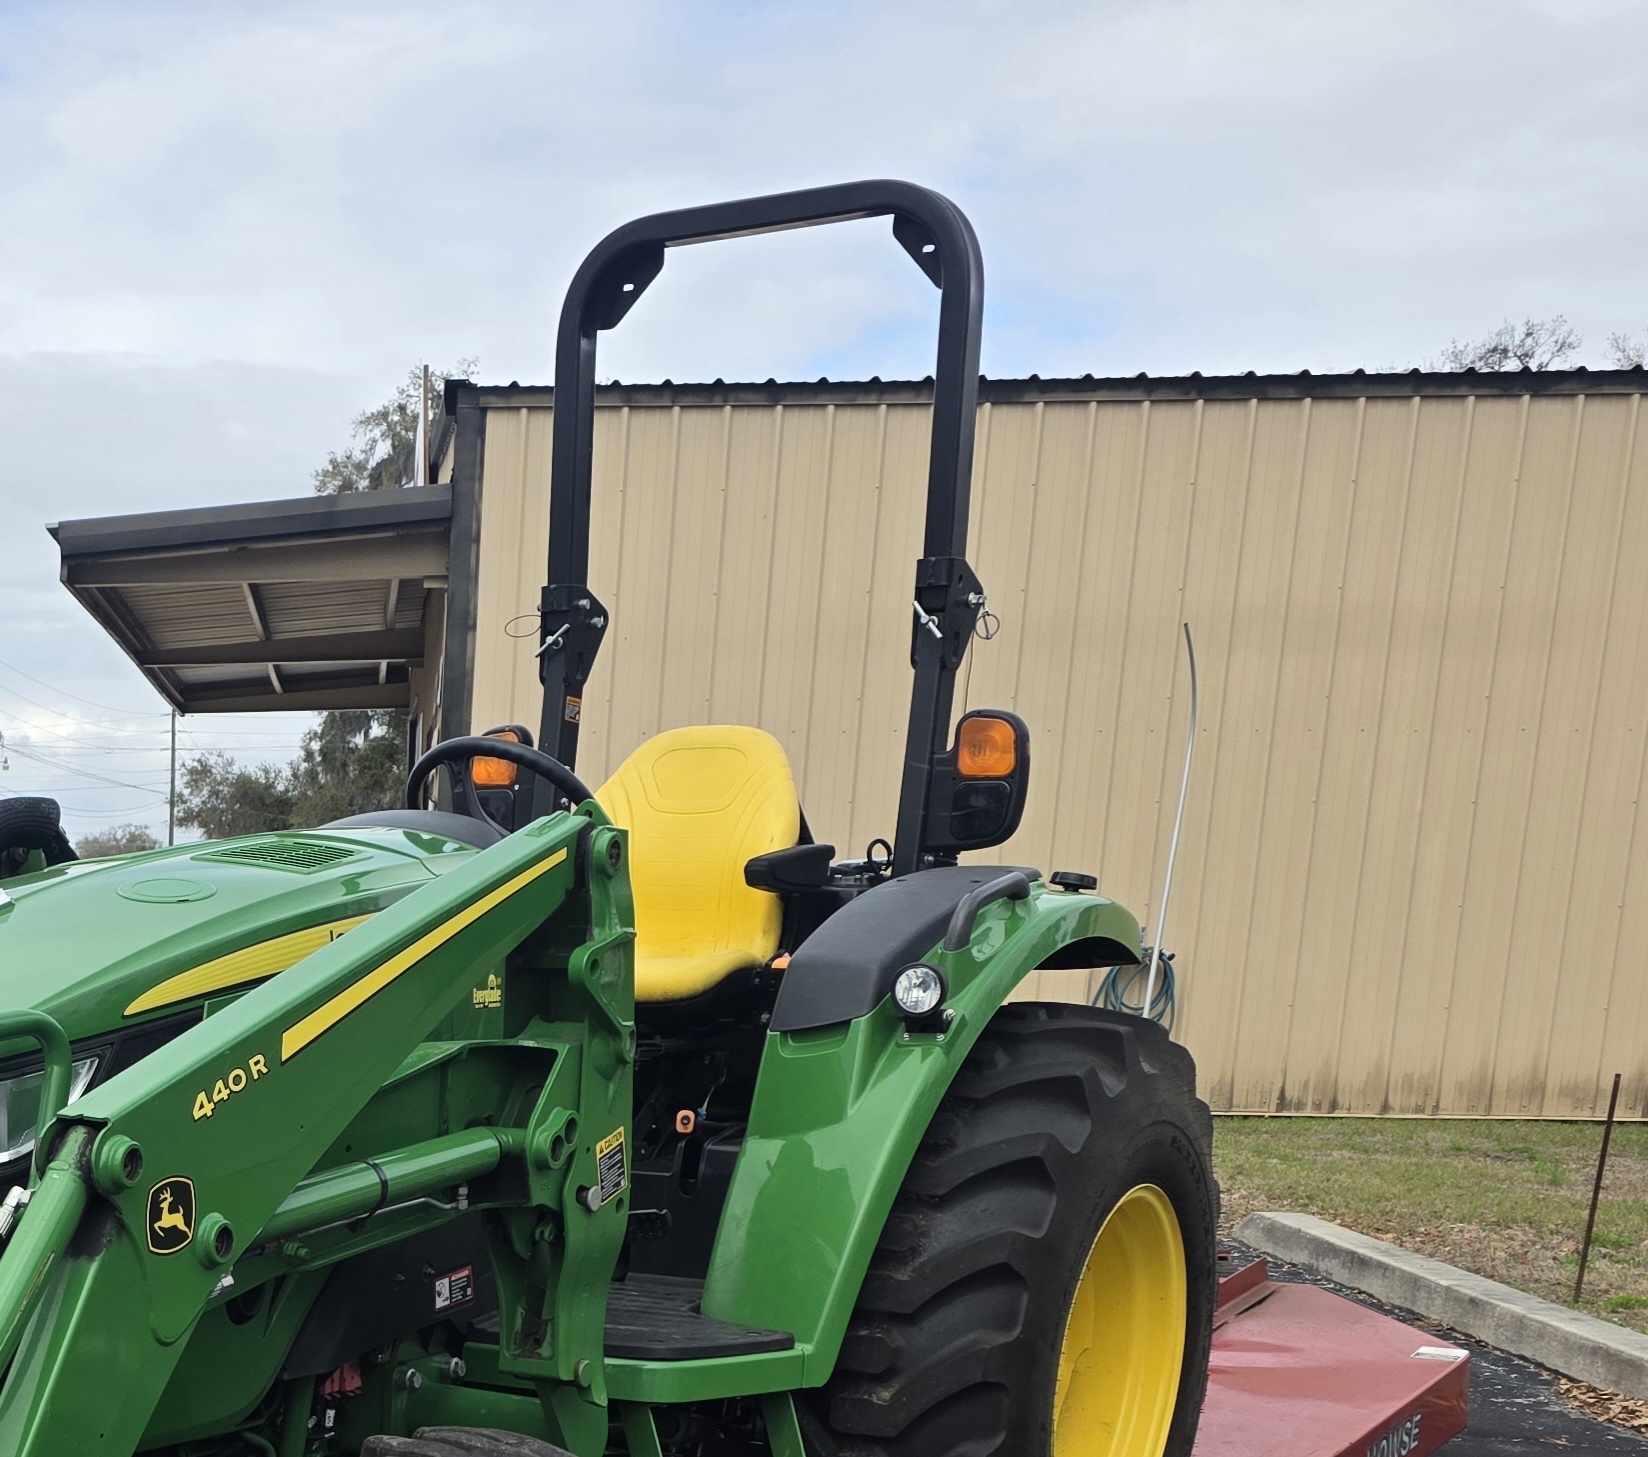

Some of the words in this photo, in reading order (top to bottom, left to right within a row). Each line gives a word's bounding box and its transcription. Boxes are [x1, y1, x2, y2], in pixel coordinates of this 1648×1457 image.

[191, 1067, 249, 1122] 440
[247, 1052, 271, 1082] R
[604, 1130, 623, 1151] CAUTION
